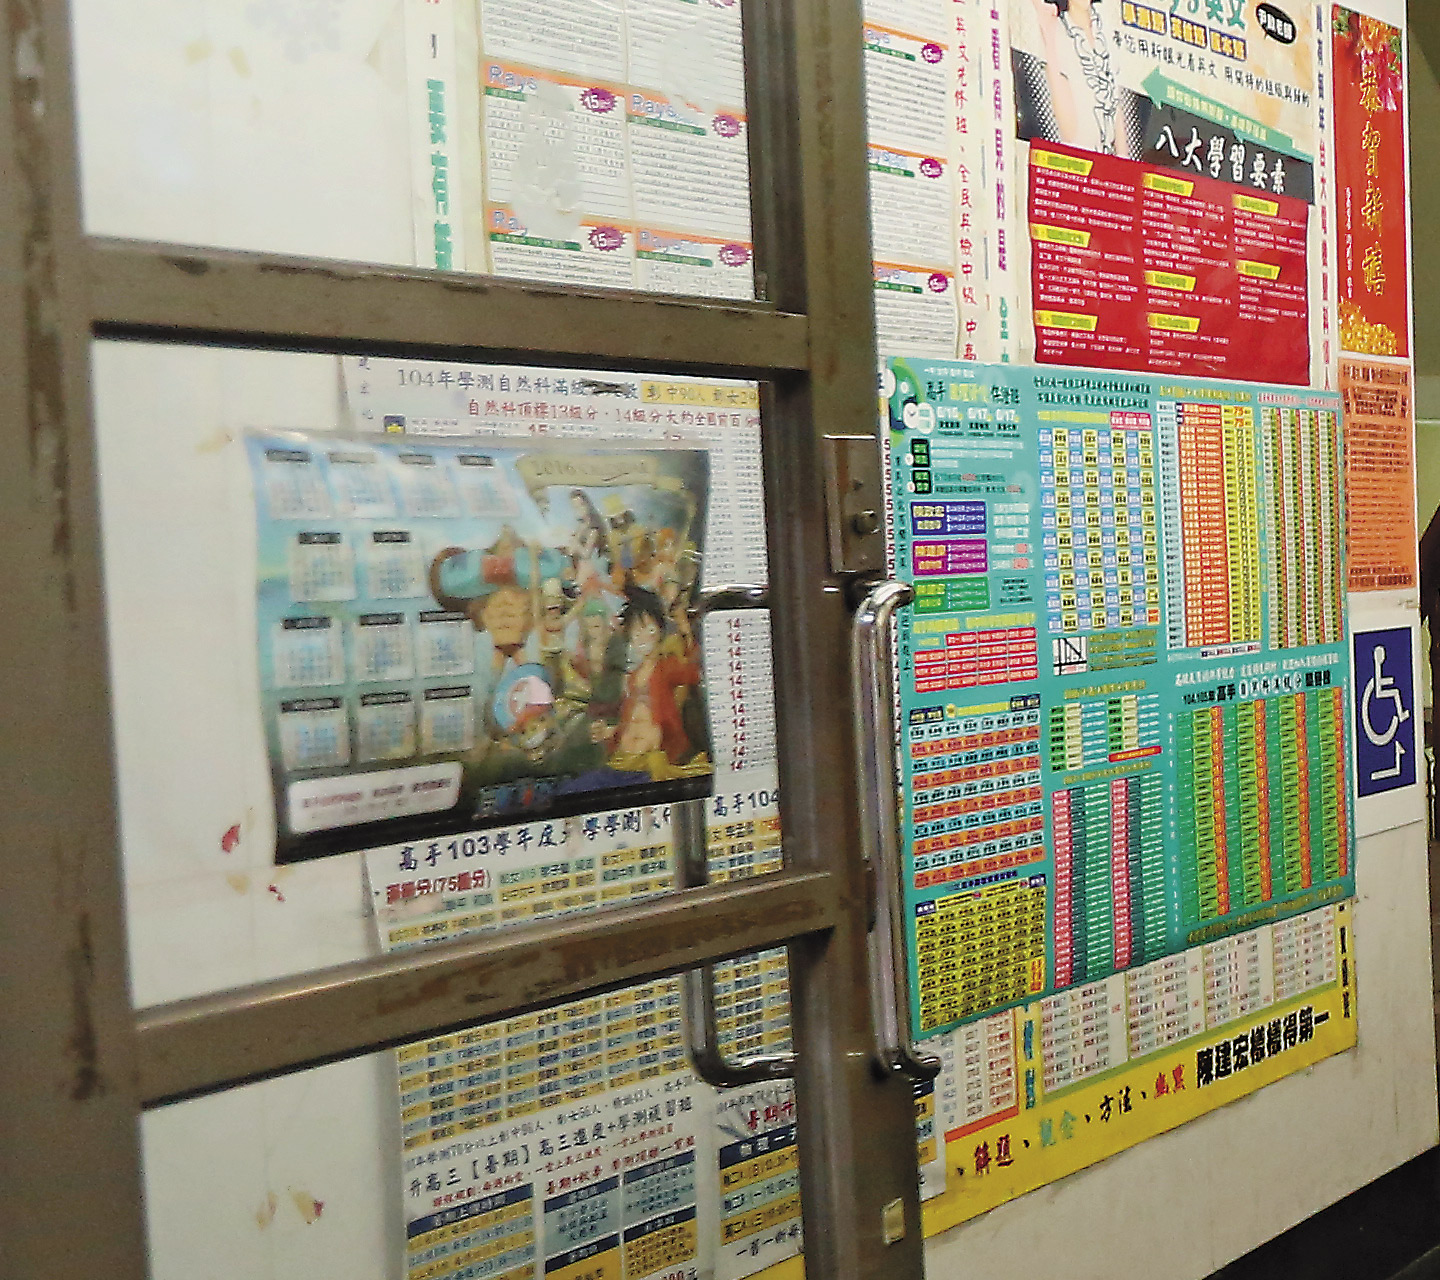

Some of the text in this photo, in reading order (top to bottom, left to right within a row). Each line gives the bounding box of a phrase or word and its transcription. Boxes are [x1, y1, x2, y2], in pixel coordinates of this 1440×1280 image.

[1155, 123, 1287, 196] 八大學習要素
